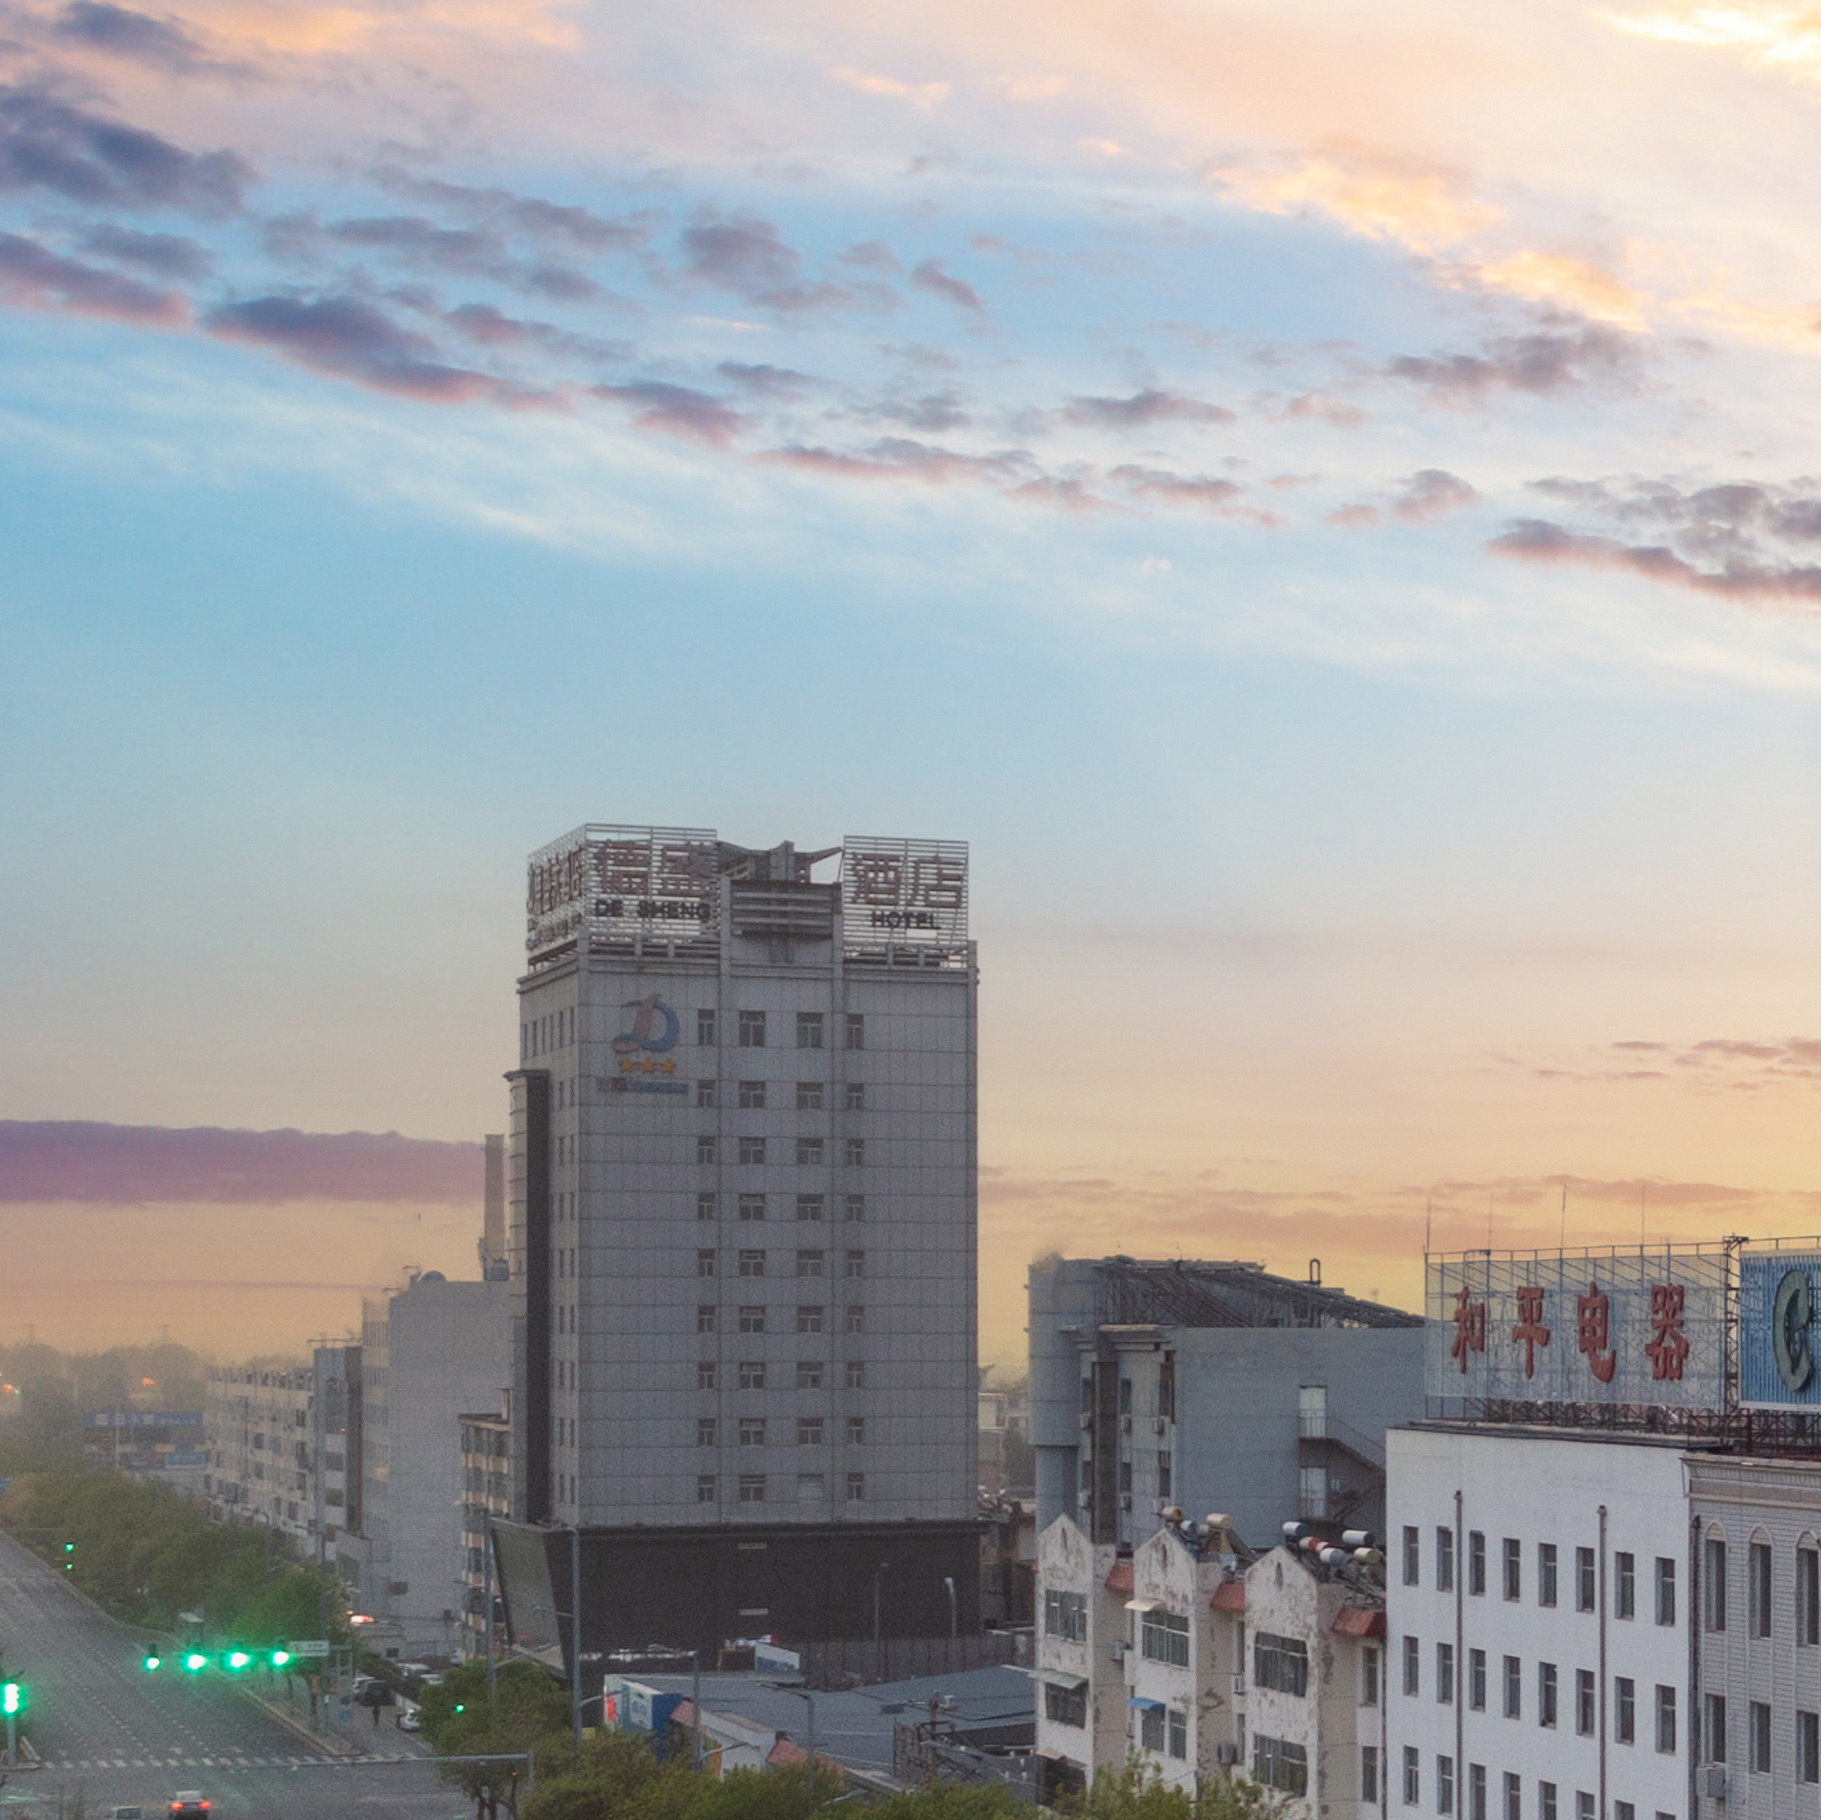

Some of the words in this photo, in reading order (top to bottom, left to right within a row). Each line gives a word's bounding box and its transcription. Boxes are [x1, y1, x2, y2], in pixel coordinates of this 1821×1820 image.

[852, 852, 962, 909] 酒店
[872, 911, 942, 929] HOTEL
[1451, 1281, 1690, 1383] 和平电器
